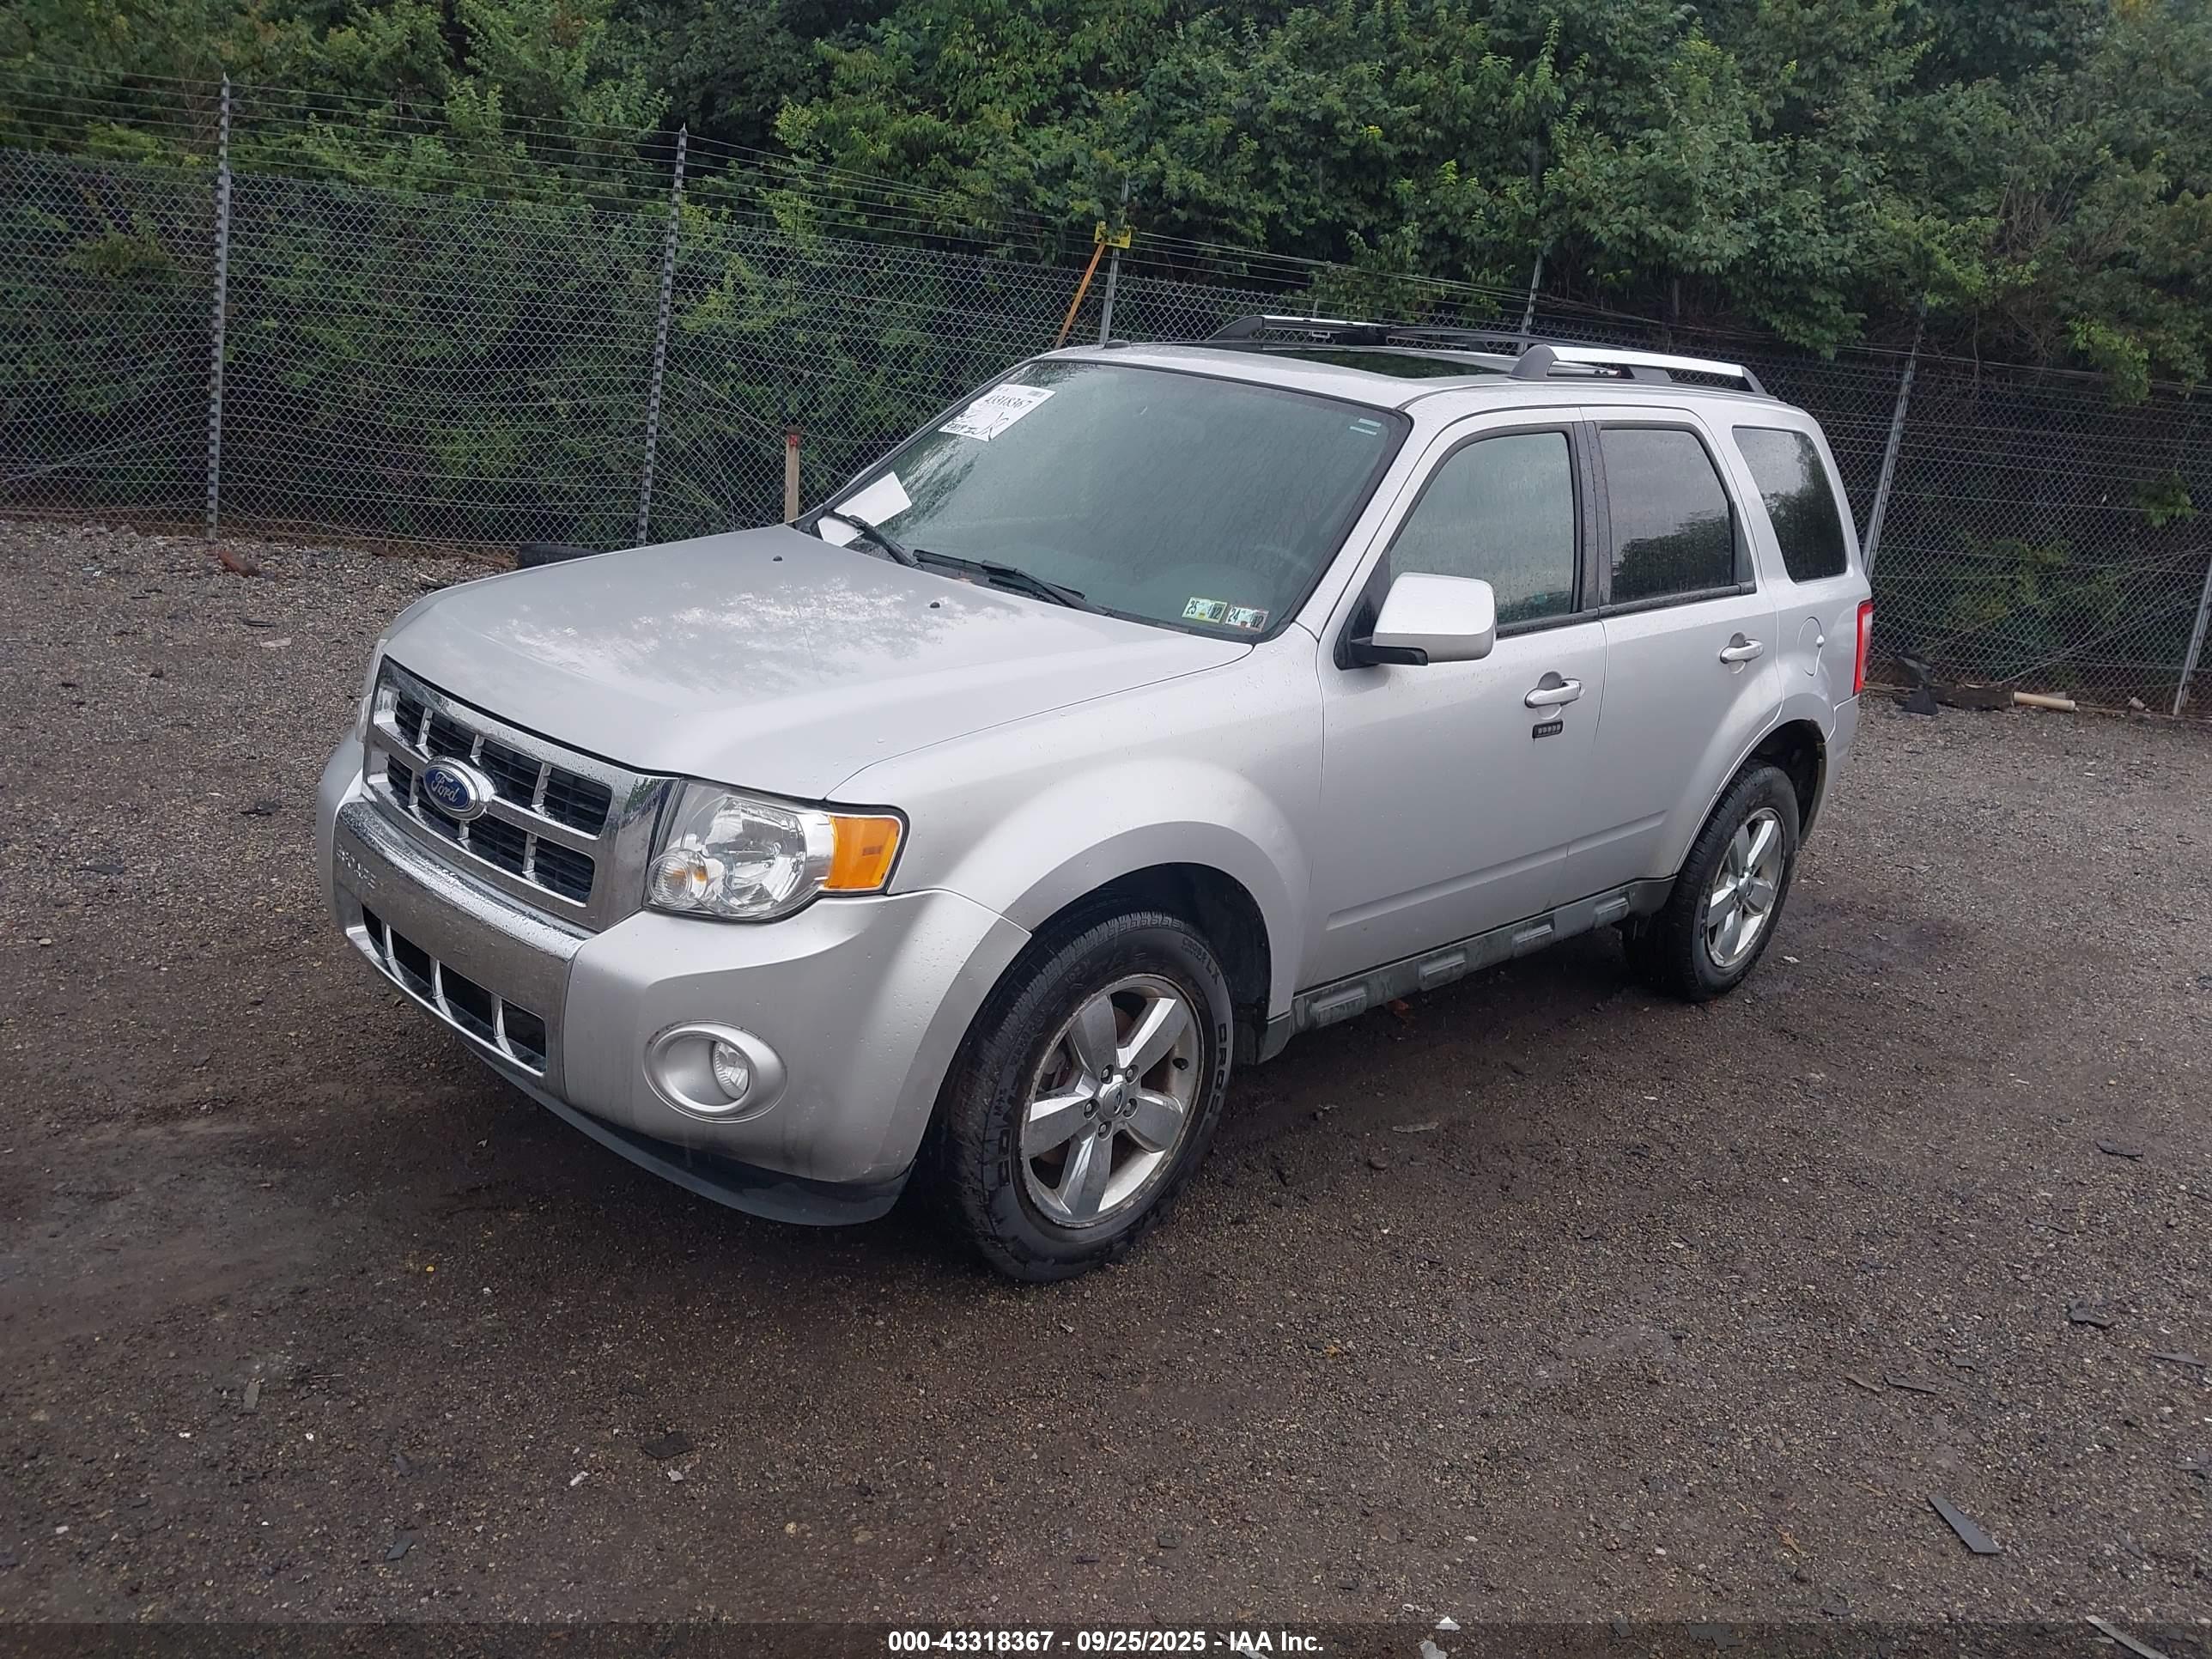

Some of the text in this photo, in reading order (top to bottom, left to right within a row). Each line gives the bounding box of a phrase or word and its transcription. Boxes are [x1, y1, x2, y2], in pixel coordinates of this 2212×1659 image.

[1186, 599, 1200, 616] 25
[1228, 606, 1242, 623] 24
[431, 771, 460, 803] Ford
